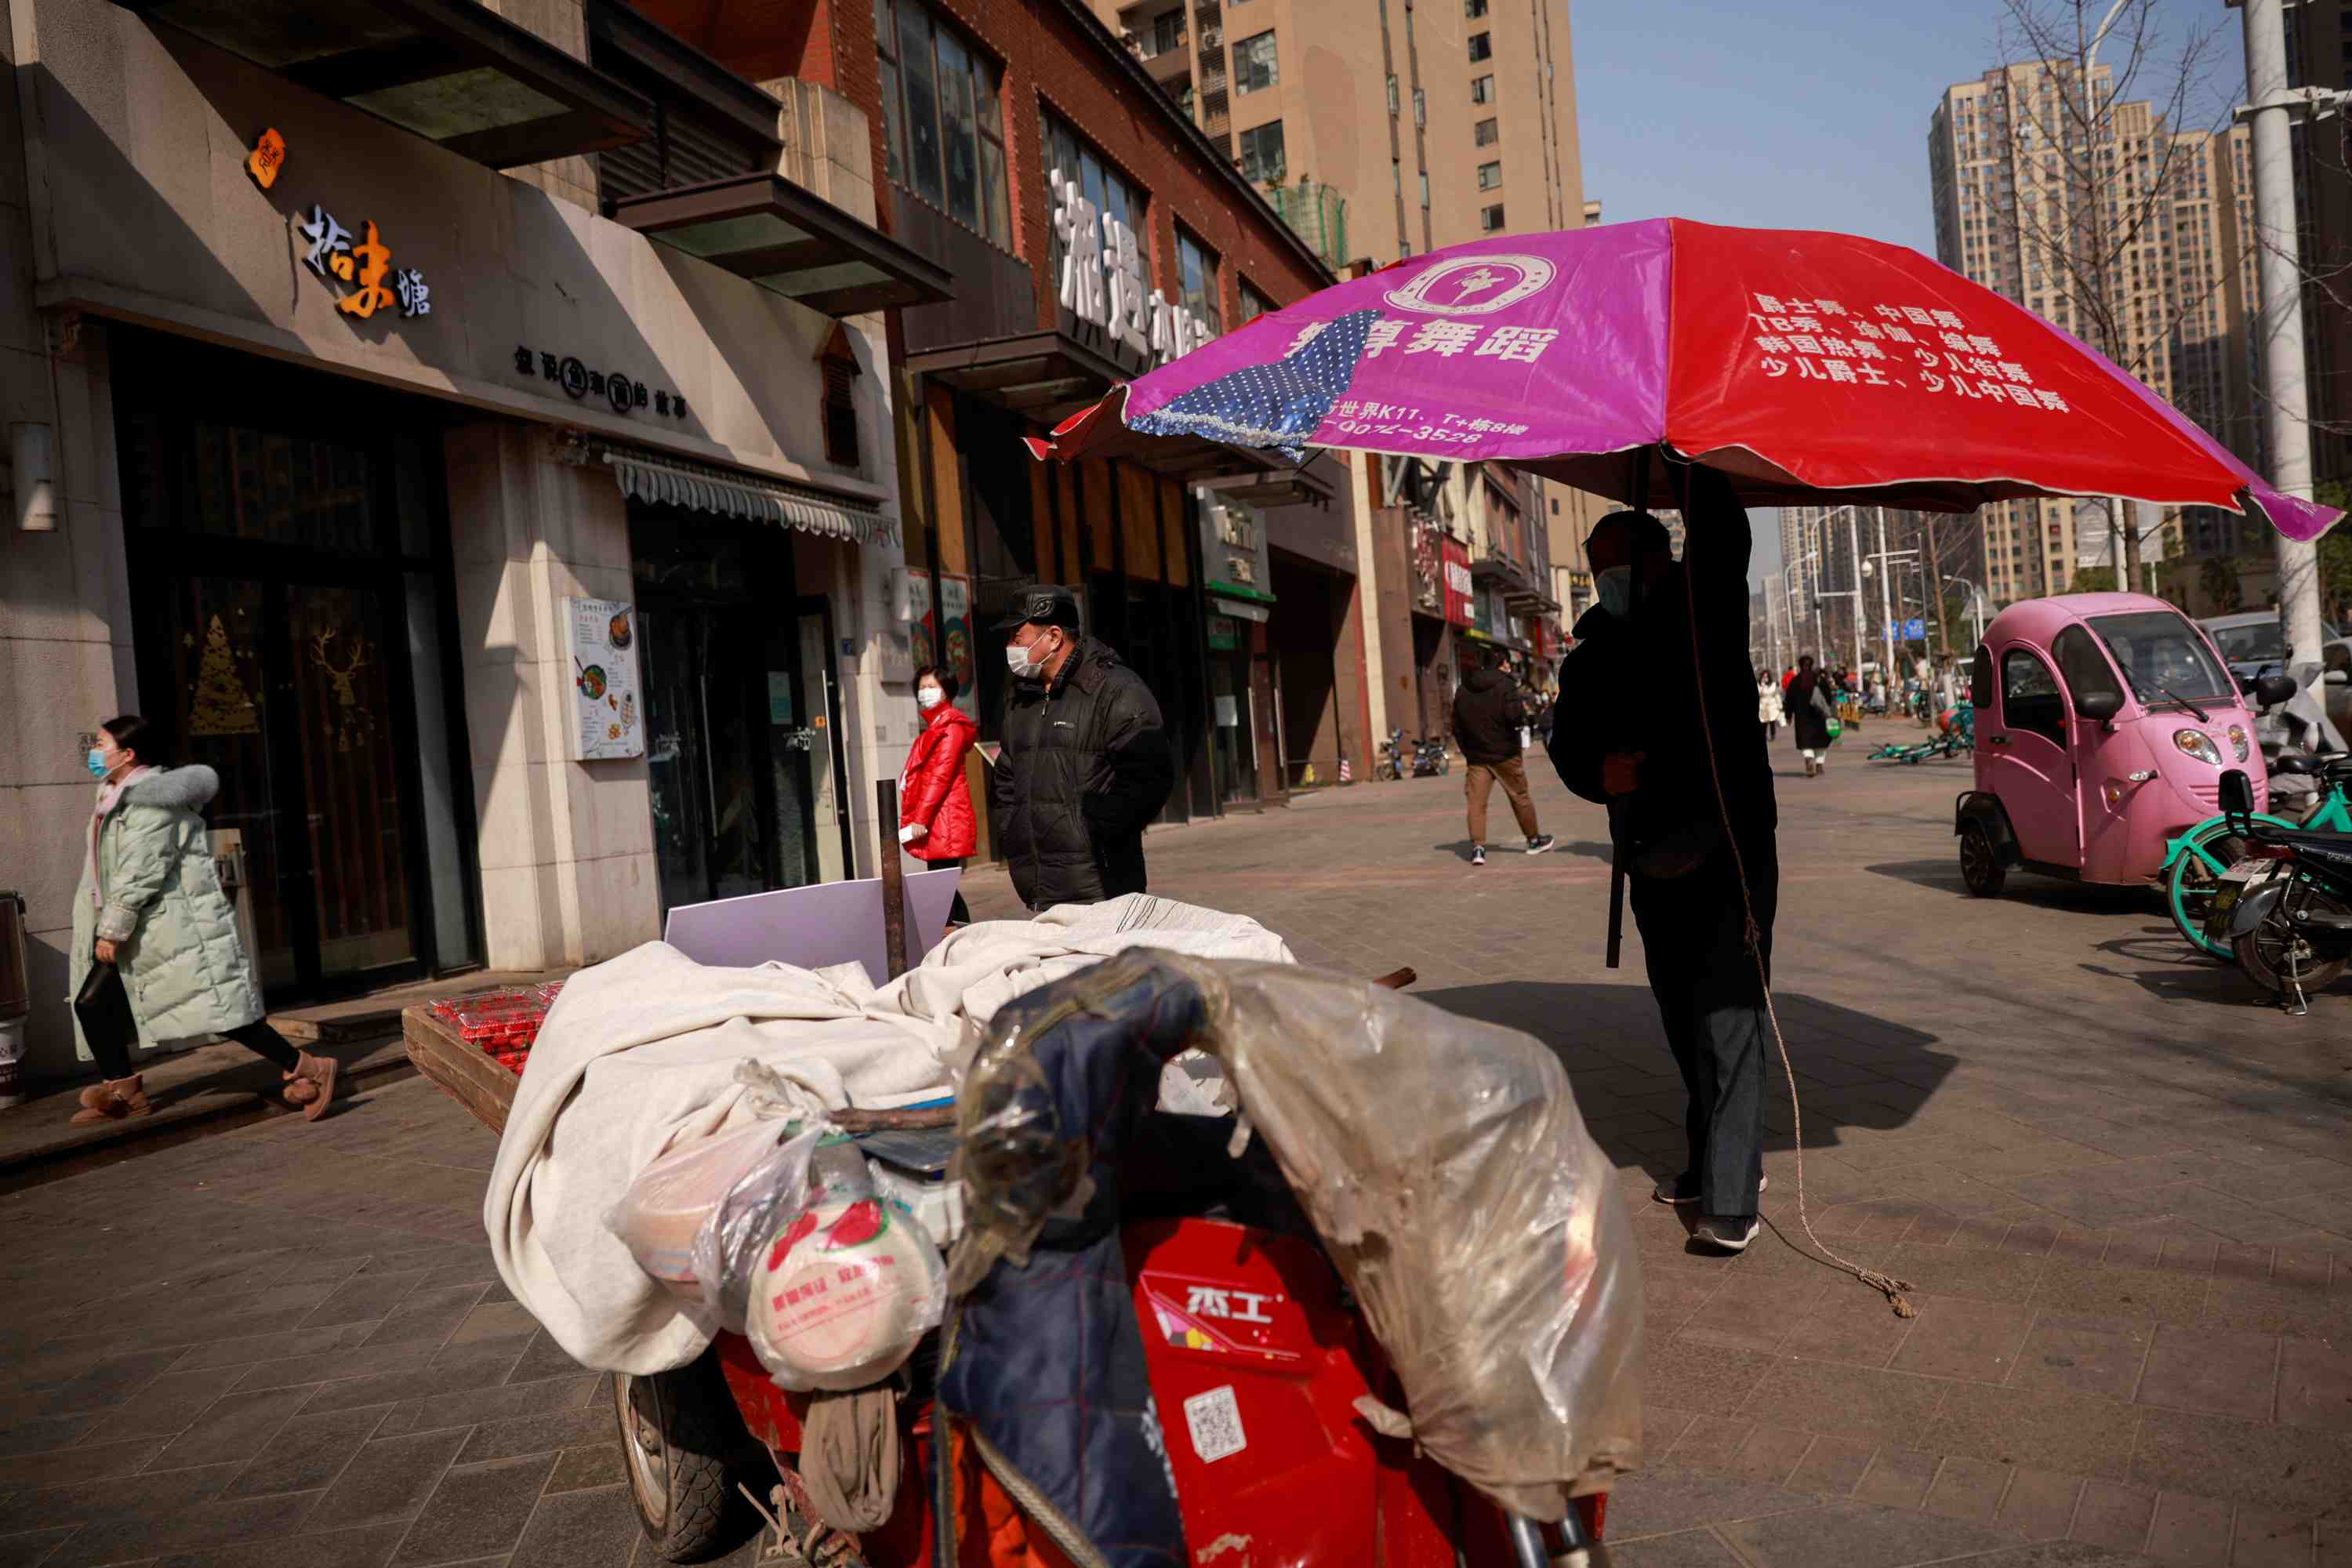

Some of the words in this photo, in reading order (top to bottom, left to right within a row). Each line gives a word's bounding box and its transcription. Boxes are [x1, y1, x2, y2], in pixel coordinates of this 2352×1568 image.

[1753, 292, 1965, 330] 爵士舞、中国舞
[1754, 335, 2033, 384] 韩国热舞、少儿街舞
[1761, 357, 2071, 414] 少儿爵士、少儿中国舞
